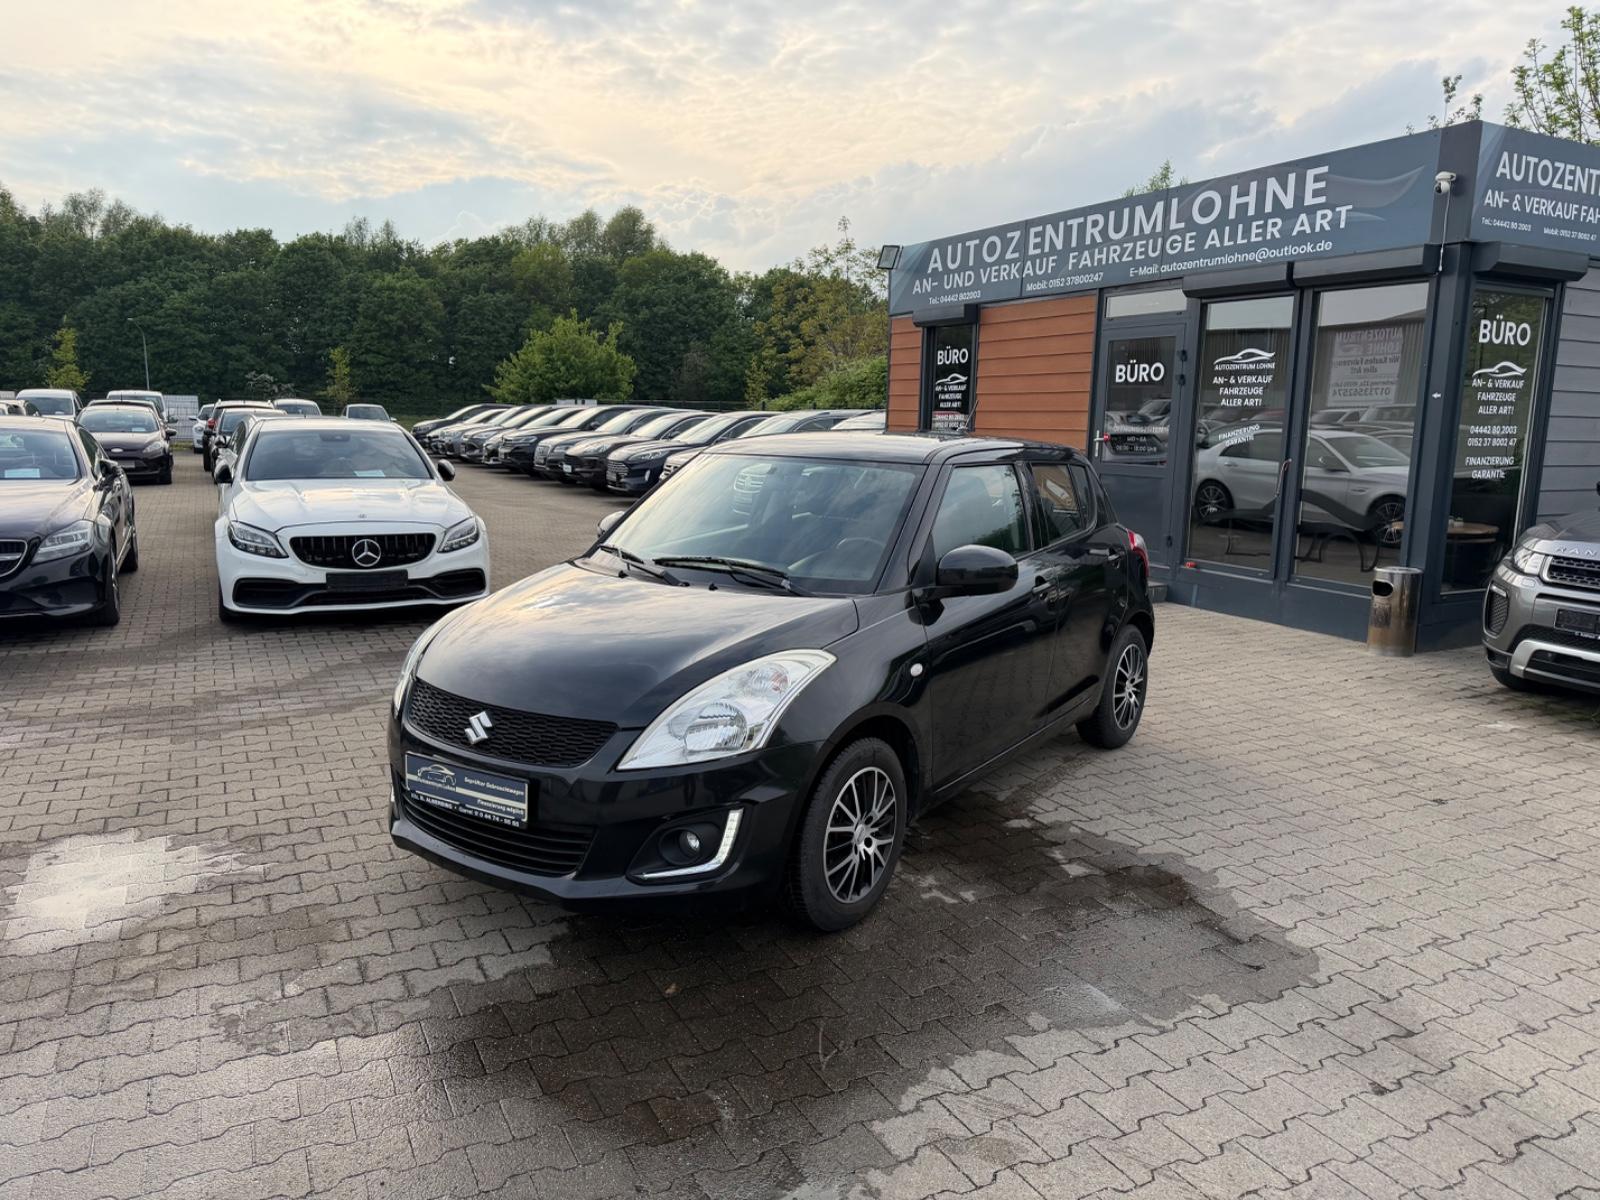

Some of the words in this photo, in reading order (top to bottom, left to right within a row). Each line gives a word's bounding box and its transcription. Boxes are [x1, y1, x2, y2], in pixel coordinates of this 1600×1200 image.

[1496, 151, 1600, 196] AUTOZENT
[1484, 189, 1509, 208] AN-
[1512, 194, 1521, 211] &
[1525, 195, 1579, 220] VERKAUF
[912, 277, 938, 295] AN-
[944, 271, 975, 289] UND
[980, 255, 1058, 284] VERKAUF
[1068, 232, 1197, 271] FAHRZEUGE
[1204, 218, 1283, 250] ALLER
[1291, 204, 1353, 236] ART
[1129, 264, 1159, 277] E-Mail:
[1160, 240, 1333, 274] autozentrumlohne@outlook.de
[1026, 281, 1048, 292] Mobil:
[1049, 278, 1065, 288] 0152
[1066, 272, 1104, 287] 37800247
[1478, 314, 1531, 346] BÜRO
[937, 345, 969, 365] BÜRO
[1115, 359, 1165, 383] BÜRO
[1214, 363, 1256, 371] AUTOZENTRUM
[1212, 376, 1228, 384] AN-
[1229, 376, 1235, 384] &
[1237, 375, 1273, 384] VERKAUF
[1471, 378, 1486, 388] AN-
[1487, 379, 1493, 388] &
[1494, 379, 1525, 389] VERKAUF
[1219, 387, 1264, 396] FAHRZEUGE
[1477, 392, 1516, 402] FAHRZEUGE
[1220, 398, 1242, 407] ALLER
[1243, 398, 1262, 407] ART!
[1478, 405, 1497, 415] ALLER
[1498, 405, 1514, 415] ART!
[1218, 423, 1260, 441] FINANZIERUNG
[1469, 425, 1491, 434] 04442
[1491, 425, 1501, 434] 80
[1501, 425, 1518, 435] 2003
[1467, 438, 1482, 446] 0152
[1483, 438, 1491, 446] 37
[1491, 438, 1508, 447] 8002
[1509, 438, 1517, 447] 47
[1465, 456, 1515, 466] FINANZIERUNG
[1471, 469, 1506, 480] GARANTIE
